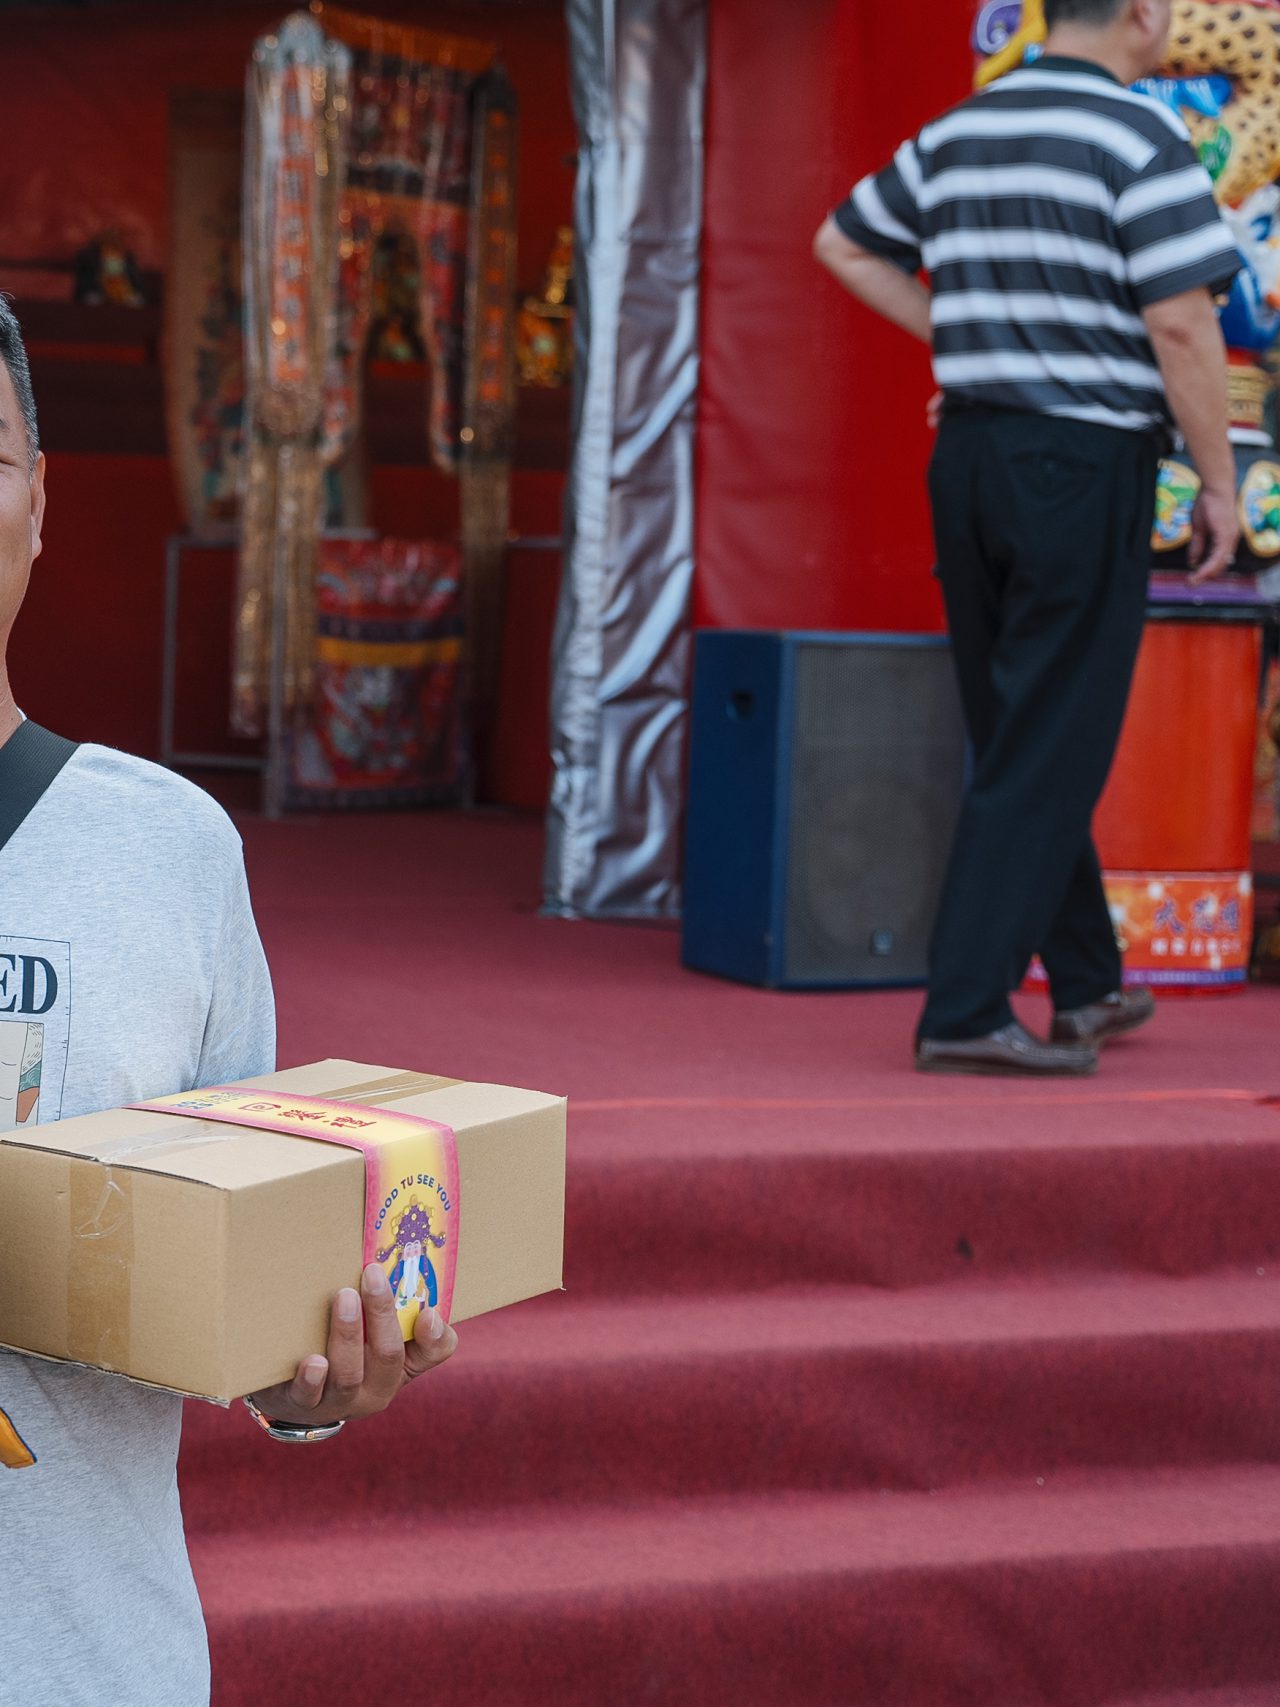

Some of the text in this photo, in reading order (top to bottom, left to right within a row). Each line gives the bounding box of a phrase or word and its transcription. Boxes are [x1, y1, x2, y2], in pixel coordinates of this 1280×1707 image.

[375, 1174, 451, 1230] GOOD TU SEE YOU
